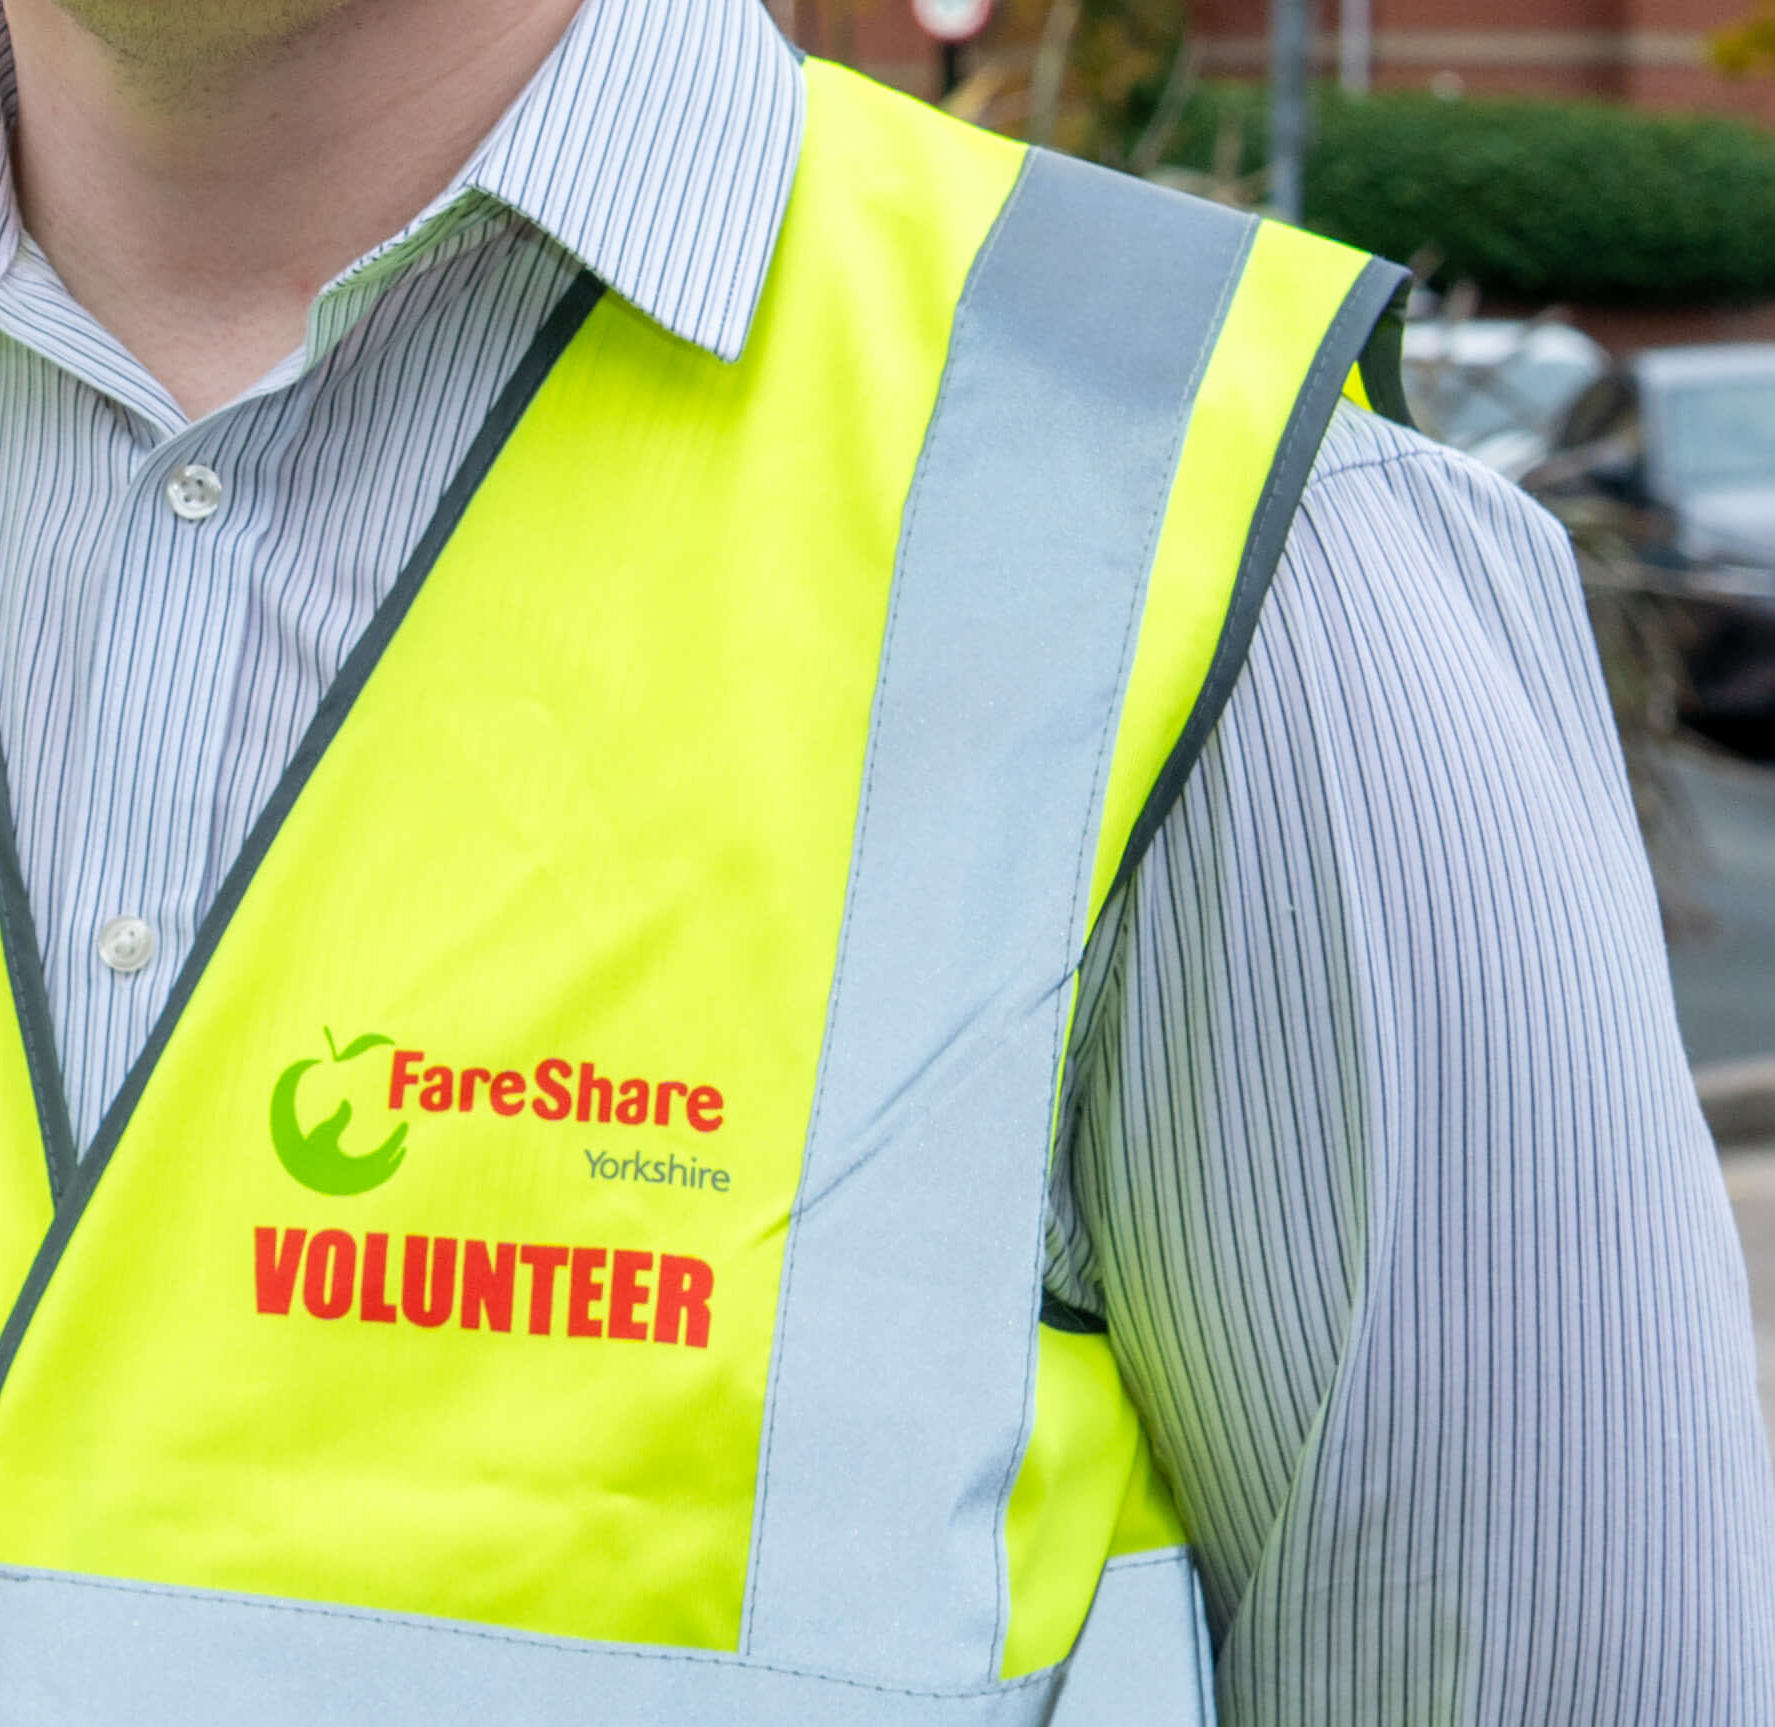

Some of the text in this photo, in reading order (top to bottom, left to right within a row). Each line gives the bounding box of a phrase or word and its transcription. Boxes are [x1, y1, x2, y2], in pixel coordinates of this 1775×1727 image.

[389, 1050, 725, 1134] FareShare
[583, 1148, 731, 1193] Yorkshire
[254, 1226, 716, 1350] VOLUNTEER
